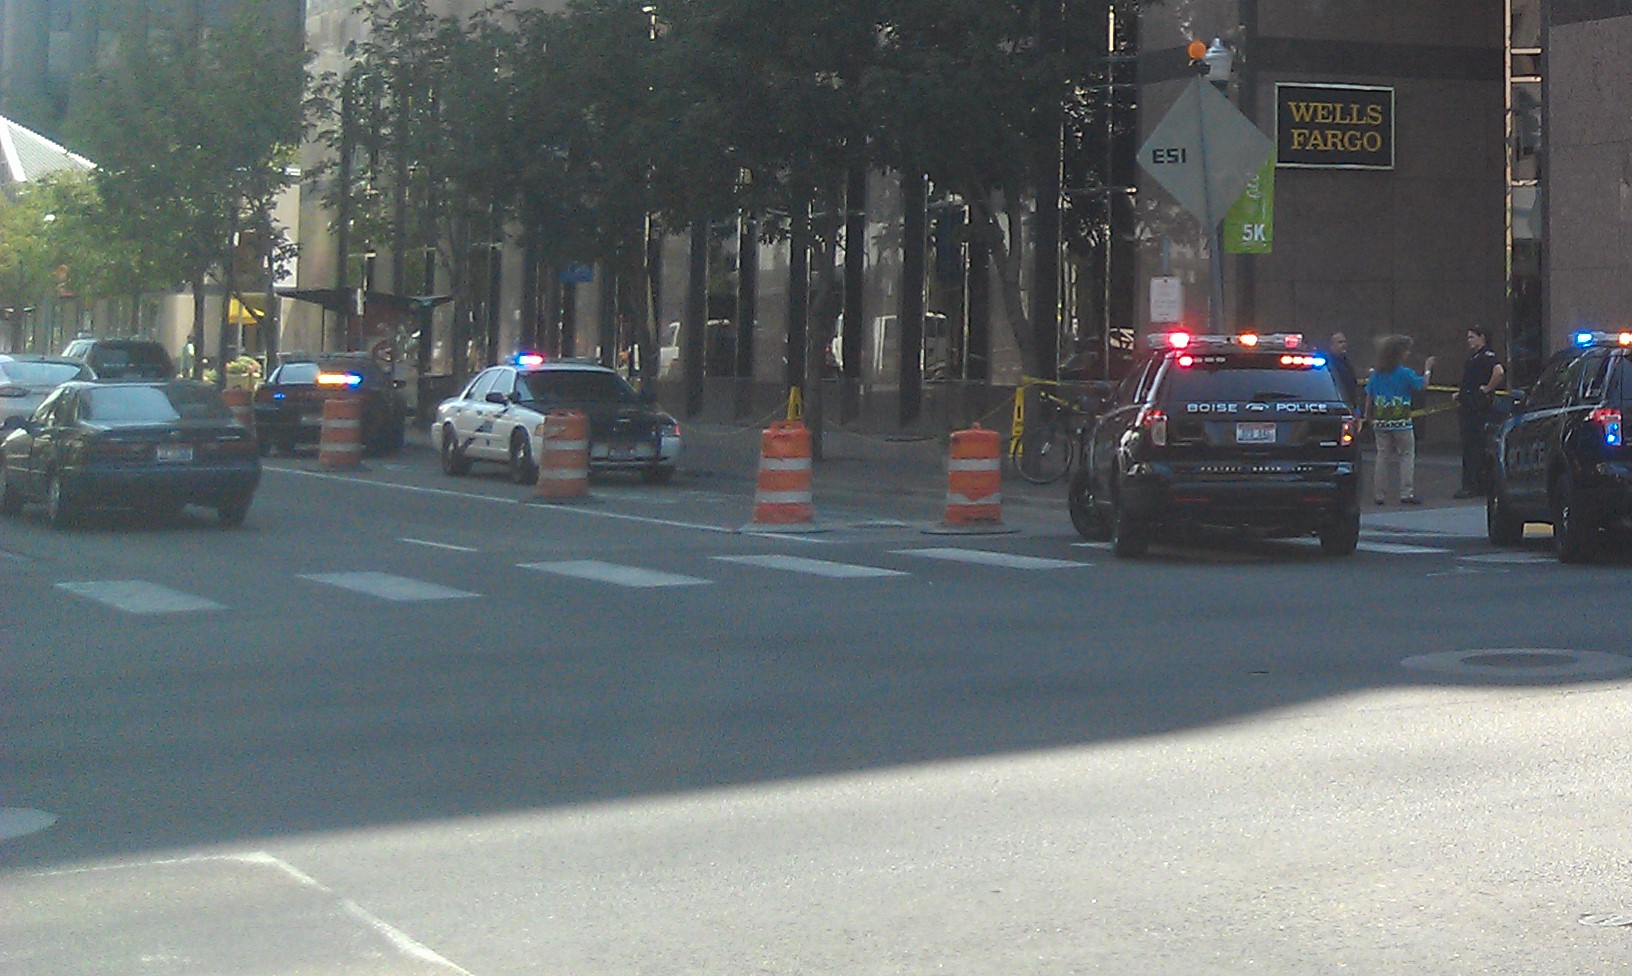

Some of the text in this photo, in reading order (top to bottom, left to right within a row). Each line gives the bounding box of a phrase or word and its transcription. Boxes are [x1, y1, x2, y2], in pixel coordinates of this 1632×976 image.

[1288, 101, 1382, 125] WELLS
[1290, 128, 1382, 152] FARGO
[1152, 148, 1186, 163] ESI
[1242, 224, 1266, 242] 5K
[1187, 403, 1327, 412] BOISE POLICE
